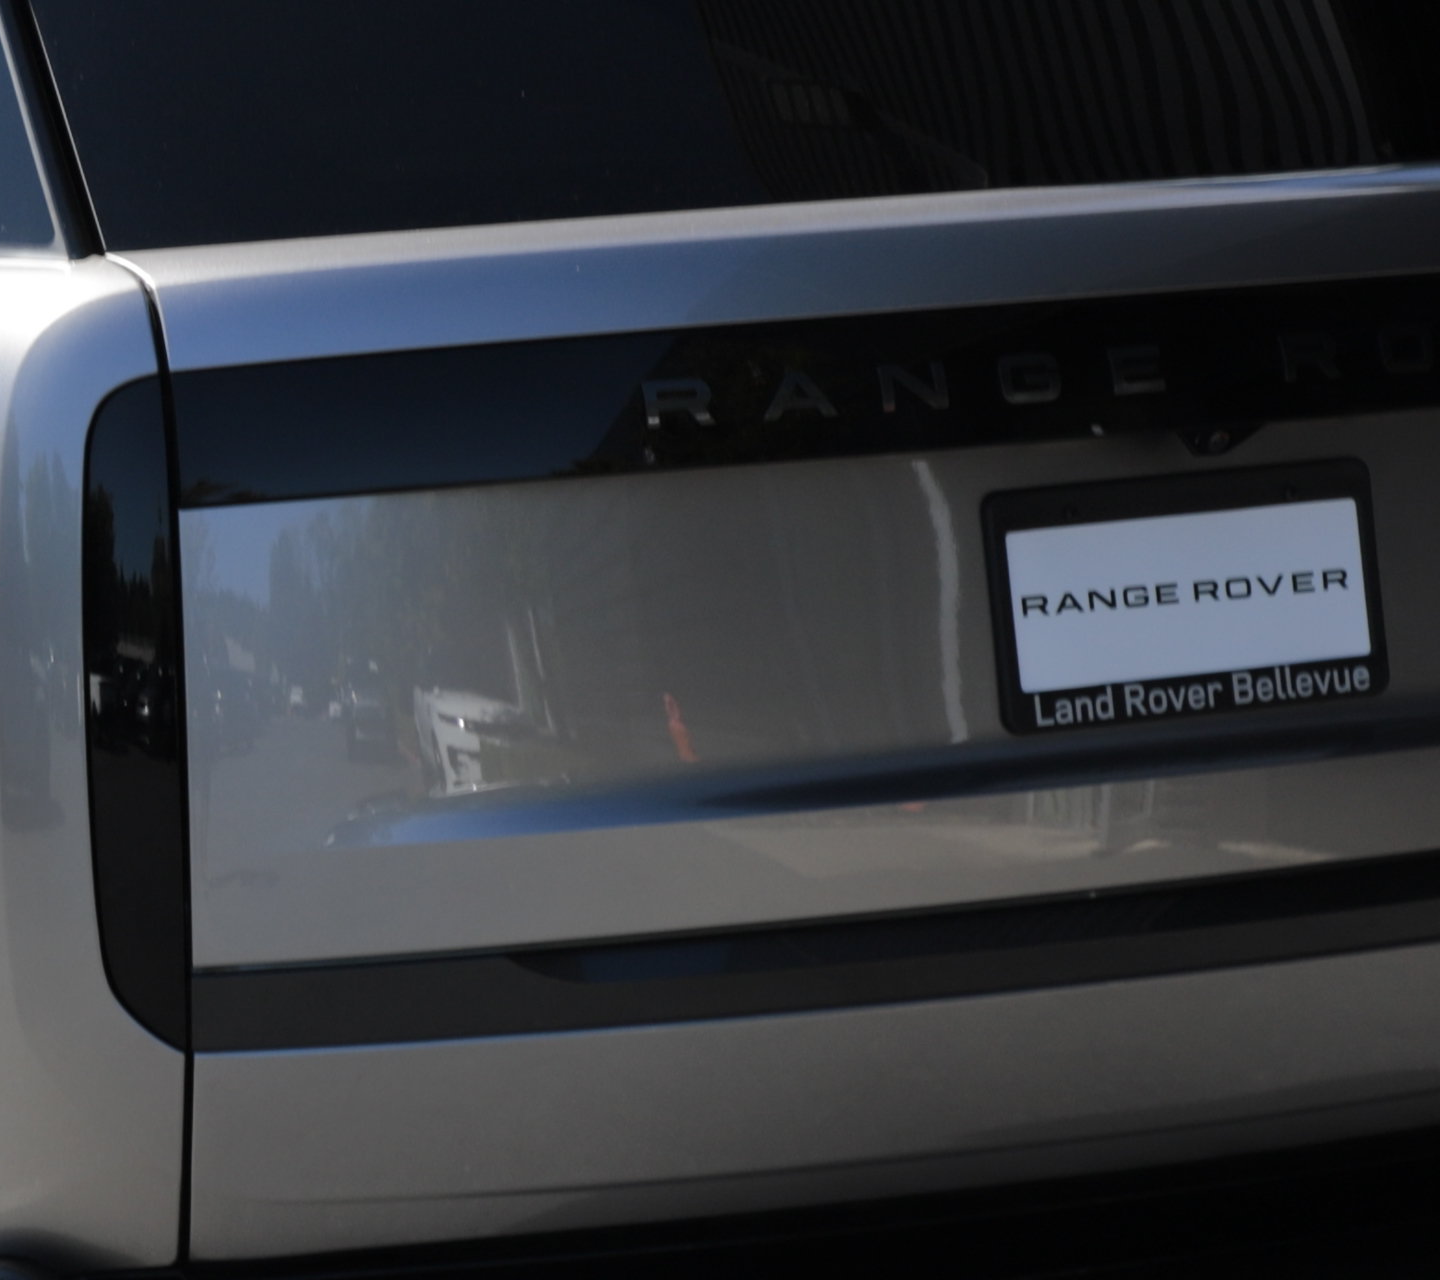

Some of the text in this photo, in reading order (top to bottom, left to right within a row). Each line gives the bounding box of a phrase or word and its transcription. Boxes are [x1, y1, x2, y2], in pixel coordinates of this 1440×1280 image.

[640, 344, 1167, 431] RANGE
[1021, 567, 1350, 618] RANGE ROVER
[1033, 665, 1371, 728] Land Rover Bellevue
